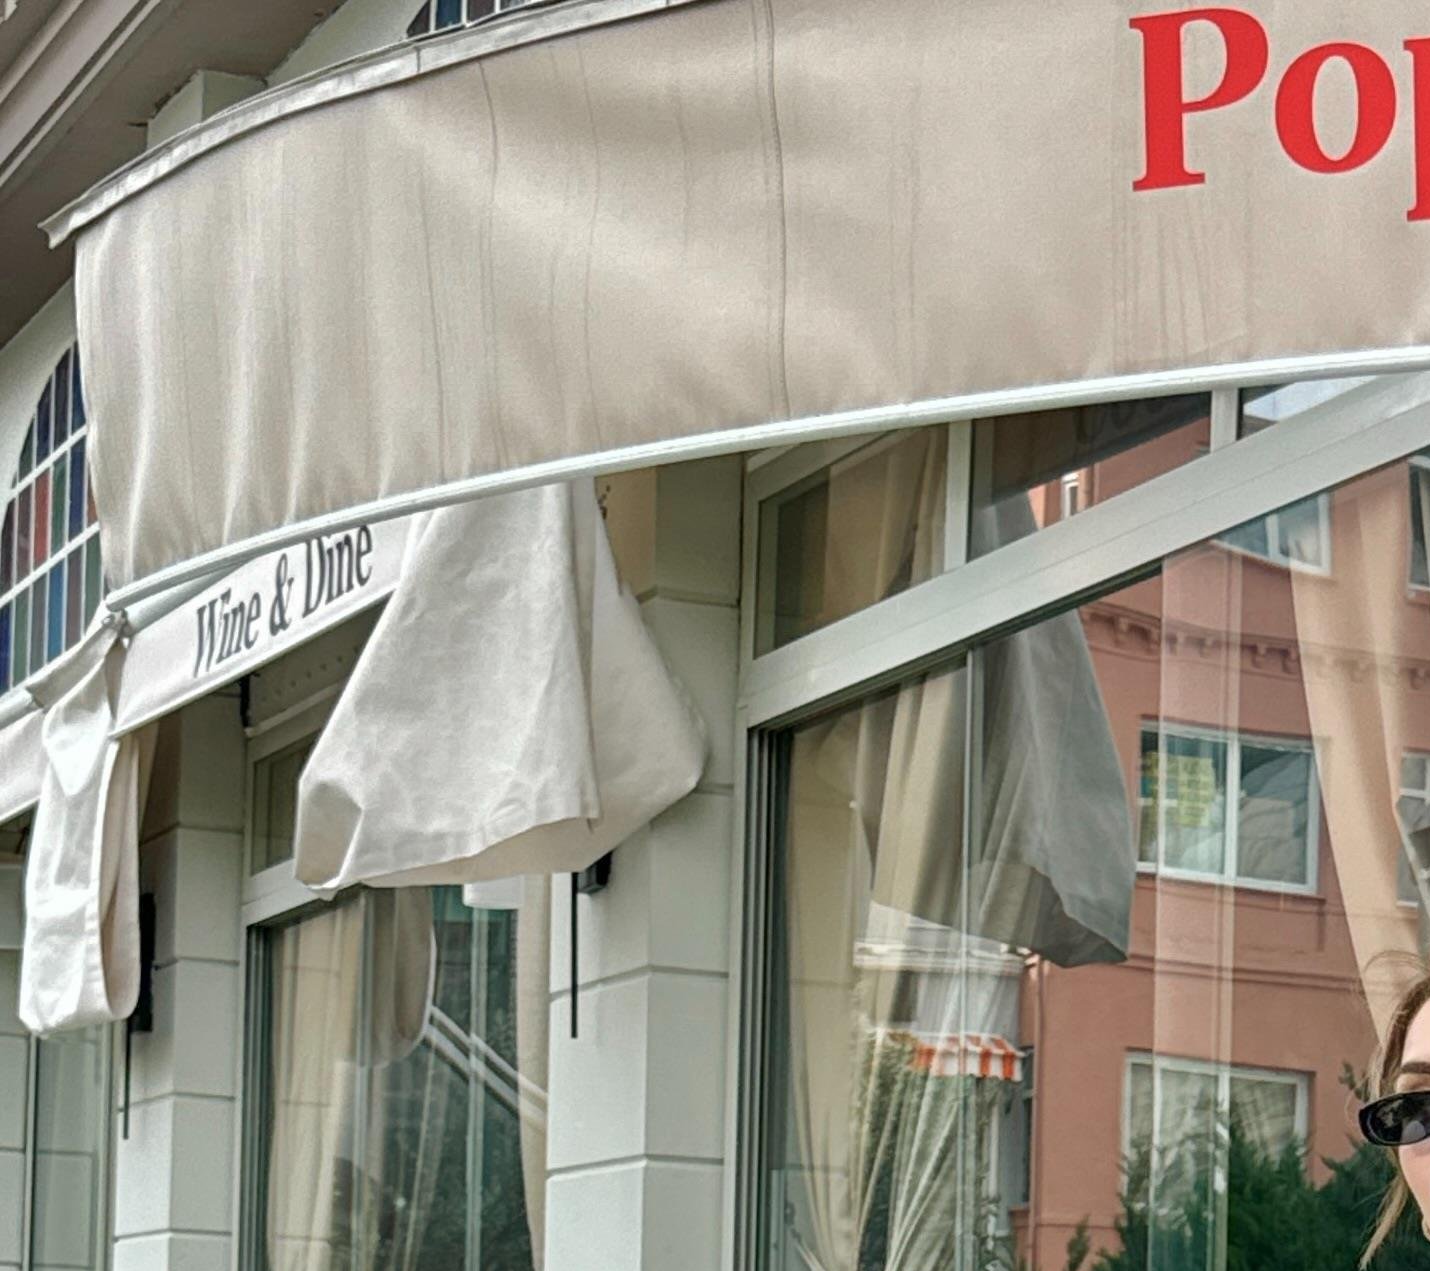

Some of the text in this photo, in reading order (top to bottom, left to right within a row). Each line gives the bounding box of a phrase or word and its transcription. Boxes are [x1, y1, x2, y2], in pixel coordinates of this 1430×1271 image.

[194, 525, 373, 679] Wine & Dine
